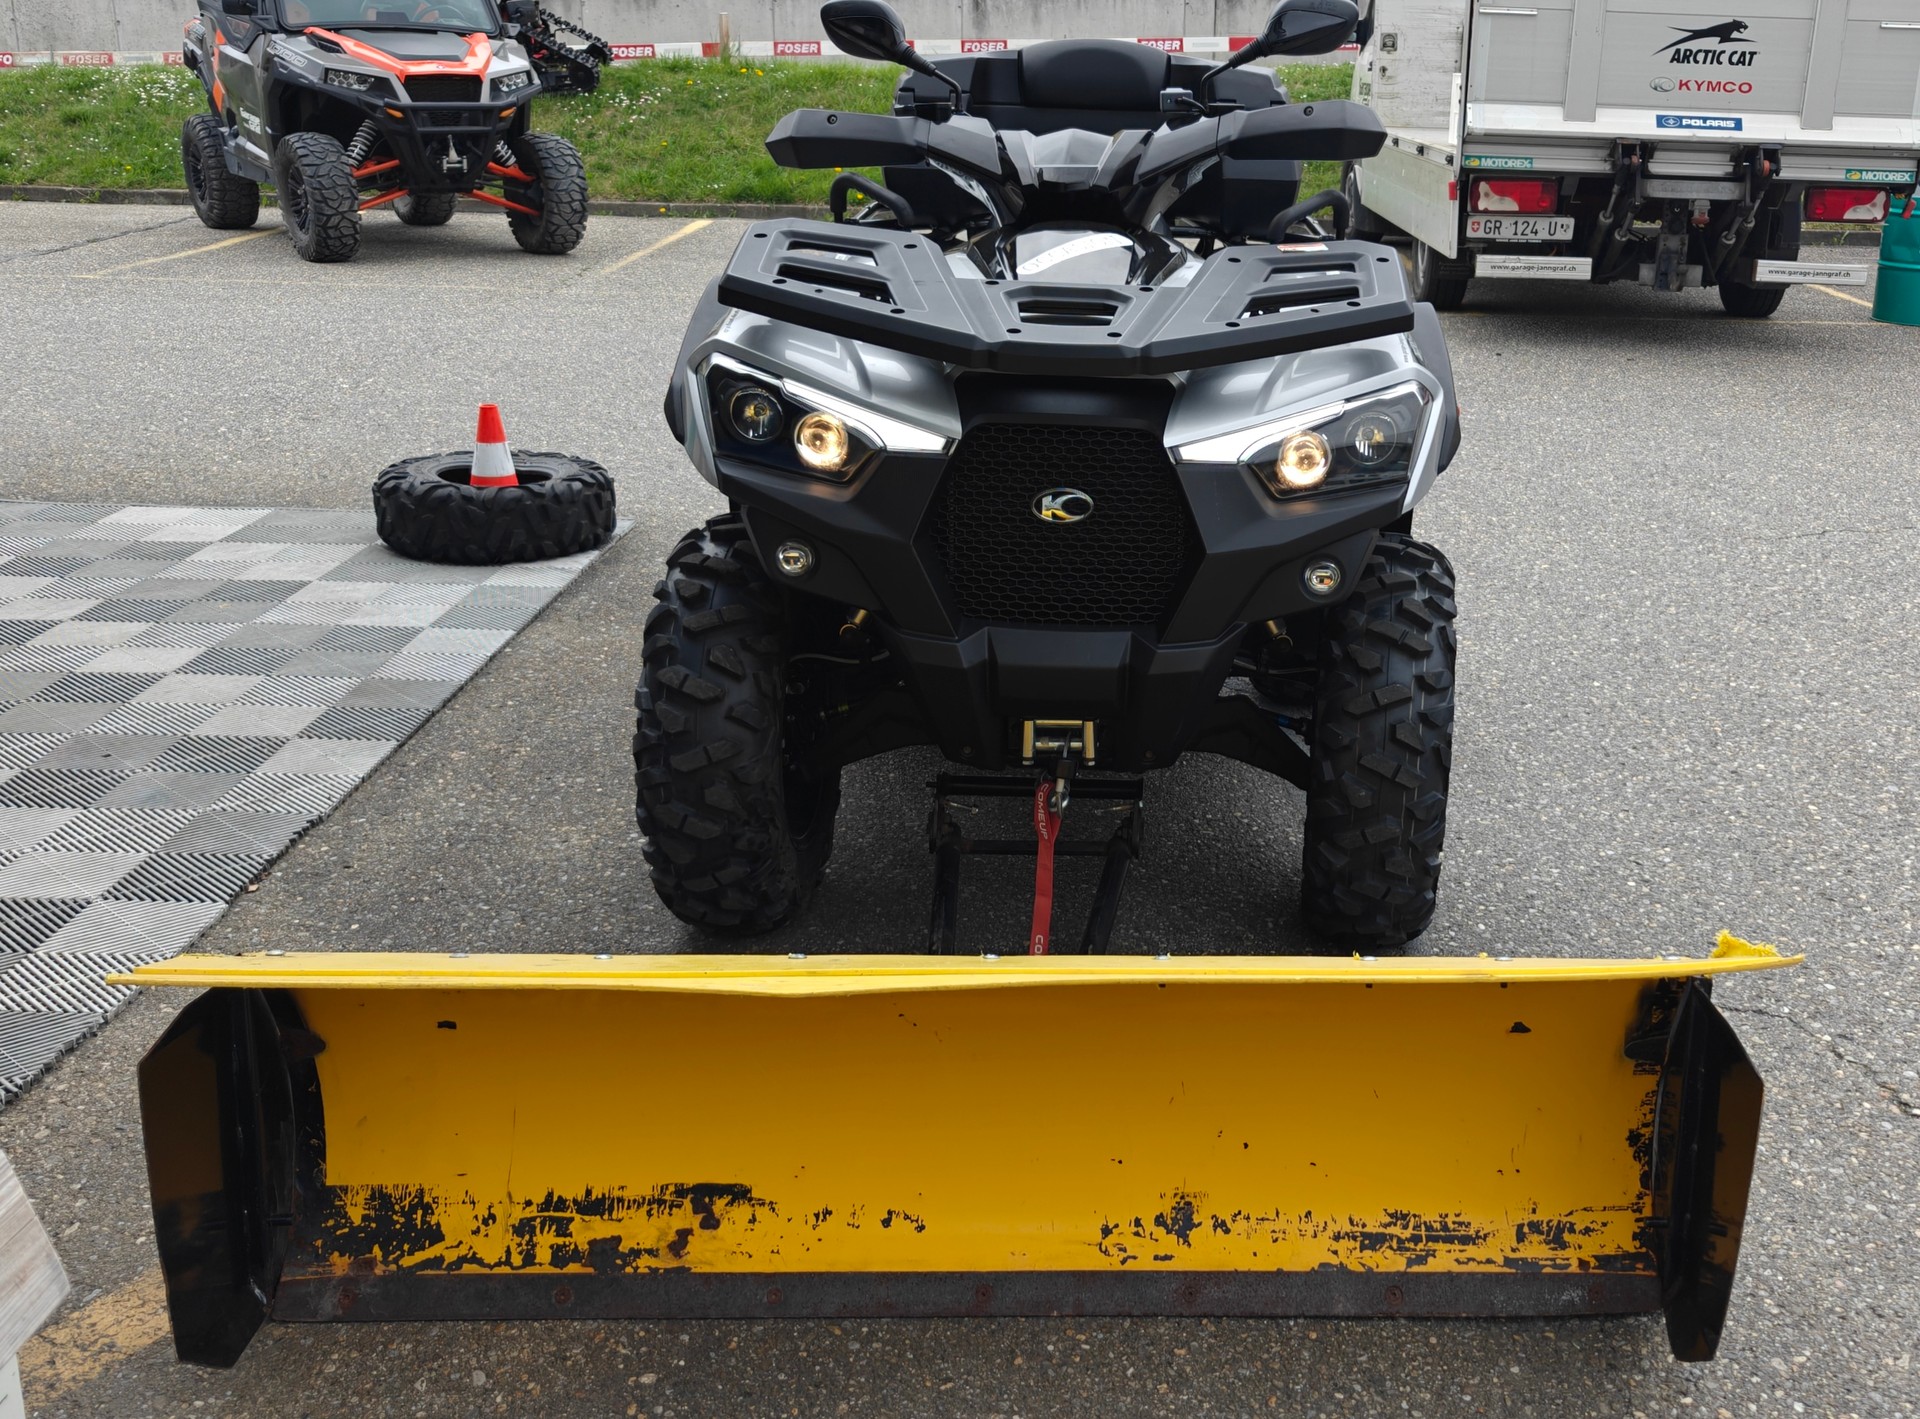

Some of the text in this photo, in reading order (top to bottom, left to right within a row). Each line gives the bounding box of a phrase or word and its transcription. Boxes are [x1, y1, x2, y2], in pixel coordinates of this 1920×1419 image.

[776, 43, 819, 54] FOSER
[964, 41, 1005, 51] FOSER
[68, 54, 109, 64] FOSER
[1669, 48, 1758, 66] ARCTIC CAT
[1678, 79, 1753, 94] KYMCO
[1682, 118, 1735, 128] POLARIS
[1861, 171, 1911, 181] MOTOREX
[1484, 219, 1558, 236] GR 124 U
[1490, 264, 1577, 272] www.garage-janngraf.ch
[1768, 268, 1851, 278] www.garage-janngraf.ch
[1036, 783, 1049, 840] COMEUP
